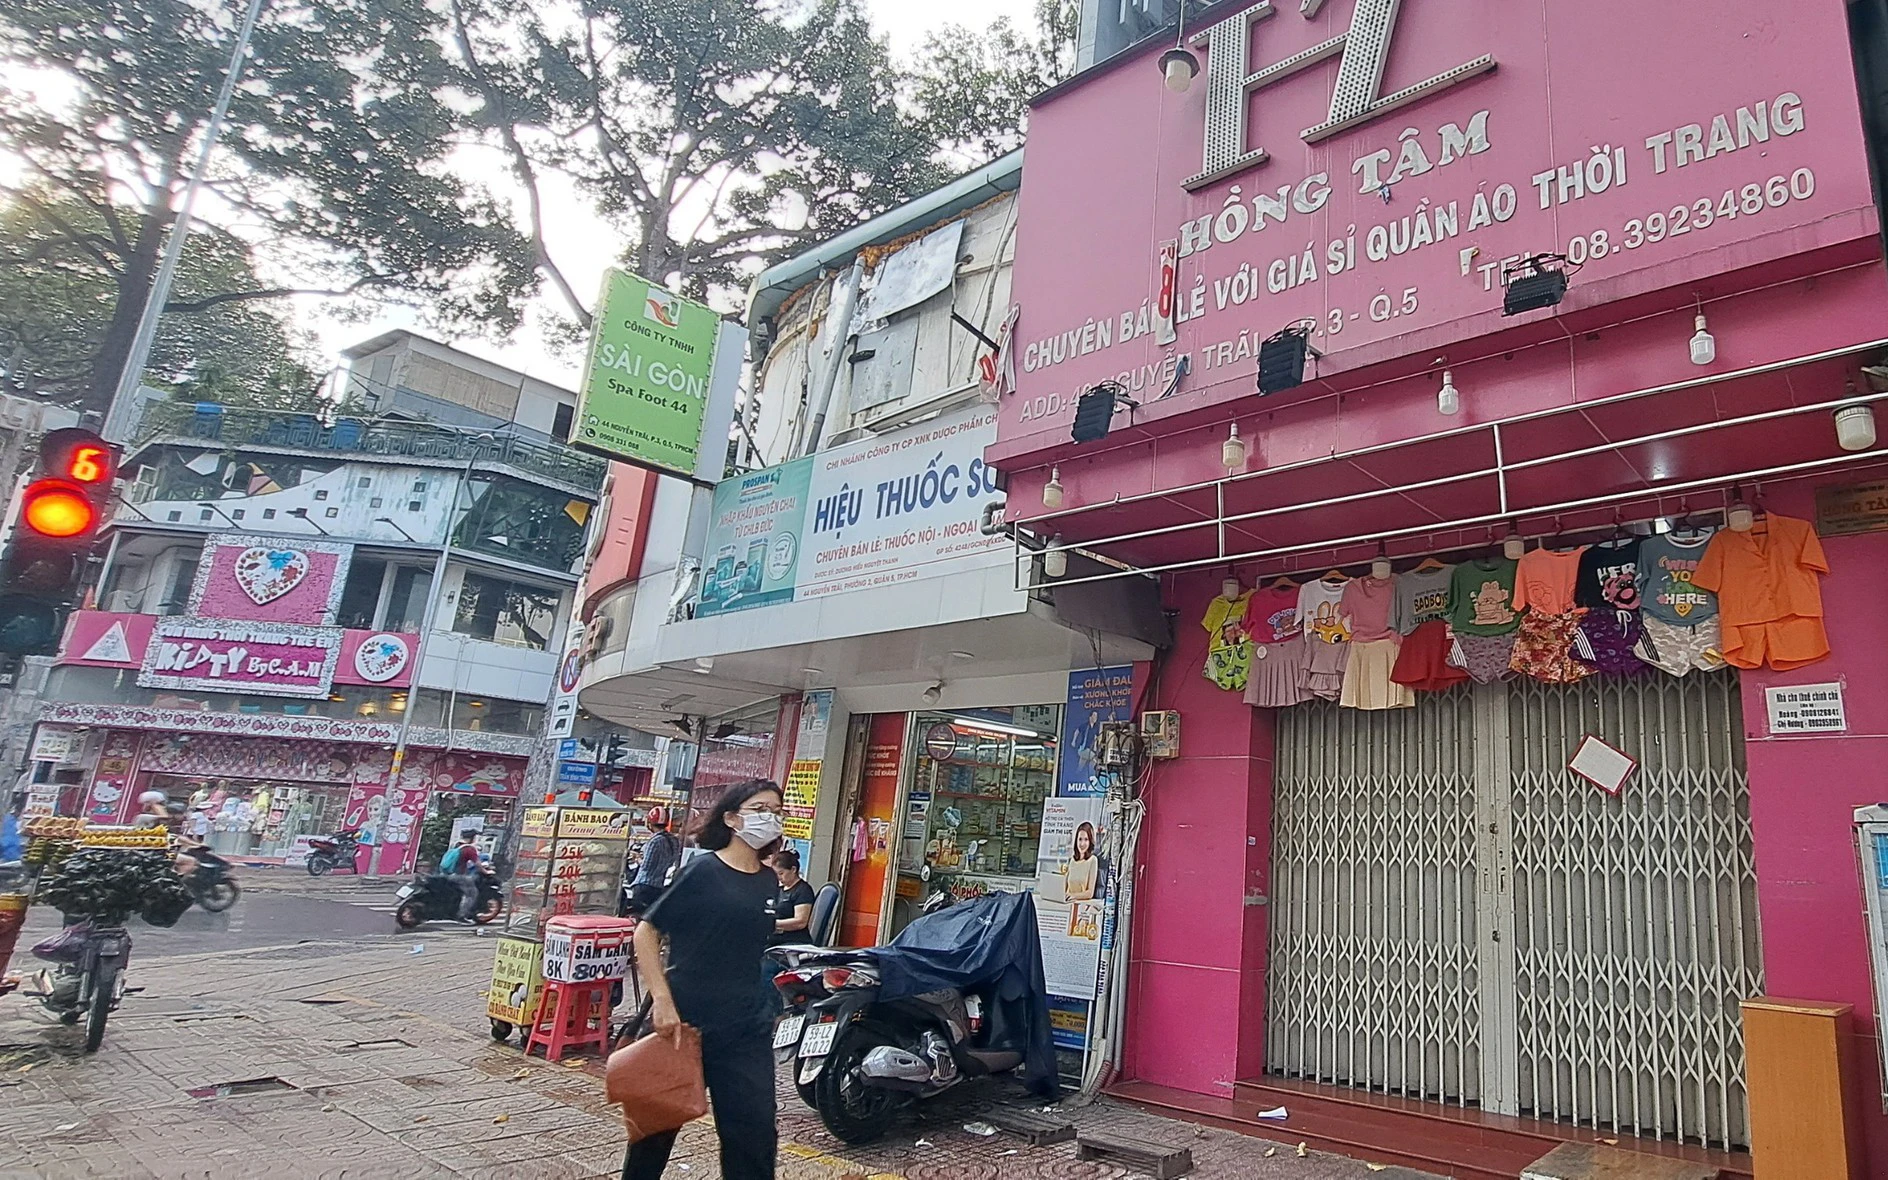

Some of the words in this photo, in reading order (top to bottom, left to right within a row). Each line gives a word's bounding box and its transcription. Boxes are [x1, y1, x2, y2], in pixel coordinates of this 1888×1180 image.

[1179, 172, 1332, 259] HỒNG
[1352, 110, 1491, 194] TÂM
[1567, 168, 1815, 265] 08.39234860
[1024, 318, 1113, 373] CHUYÊN
[1176, 275, 1206, 324] LẺ
[1214, 261, 1259, 311] VỚI
[1267, 241, 1318, 295] GIÁ
[1327, 224, 1356, 276] SỈ
[1366, 197, 1459, 262] QUẦN
[1467, 181, 1518, 232] ÁO
[1532, 143, 1628, 210] THỜI
[1645, 92, 1805, 174] TRANG
[624, 319, 651, 337] CÔNG
[653, 331, 666, 343] TY
[669, 336, 695, 355] TNHH
[1201, 329, 1260, 370] TRÃI
[600, 343, 642, 377] SÀI
[647, 361, 704, 400] GÒN
[607, 378, 634, 397] Spa
[638, 388, 668, 408] Foot
[670, 400, 688, 415] 44
[601, 420, 610, 428] 44
[826, 461, 838, 471] CHI
[840, 451, 866, 467] NHÁNH
[867, 445, 889, 459] CÔNG
[891, 442, 900, 452] TY
[902, 439, 913, 449] CP
[915, 434, 931, 446] XNK
[933, 425, 956, 440] DƯỢC
[958, 415, 983, 433] PHẨM
[985, 413, 999, 425] CH
[71, 448, 102, 481] 6
[742, 474, 770, 490] PROSPAN
[814, 482, 862, 539] HIỆU
[876, 451, 960, 519] THUỐC
[1866, 496, 1888, 511] TÂ
[816, 545, 849, 564] CHUYÊN
[851, 540, 869, 556] BÁN
[884, 529, 914, 550] THUỐC
[918, 525, 935, 545] NỘI
[944, 519, 977, 539] NGOẠI
[1670, 570, 1691, 582] YO
[1664, 594, 1707, 604] HERE
[1067, 782, 1088, 792] MUA
[564, 812, 589, 823] BÁNH
[590, 815, 608, 824] BAO
[561, 846, 583, 859] 25k
[558, 865, 581, 879] 20k
[554, 883, 576, 898] 15k
[575, 942, 604, 960] SÂM
[547, 959, 563, 979] 8K
